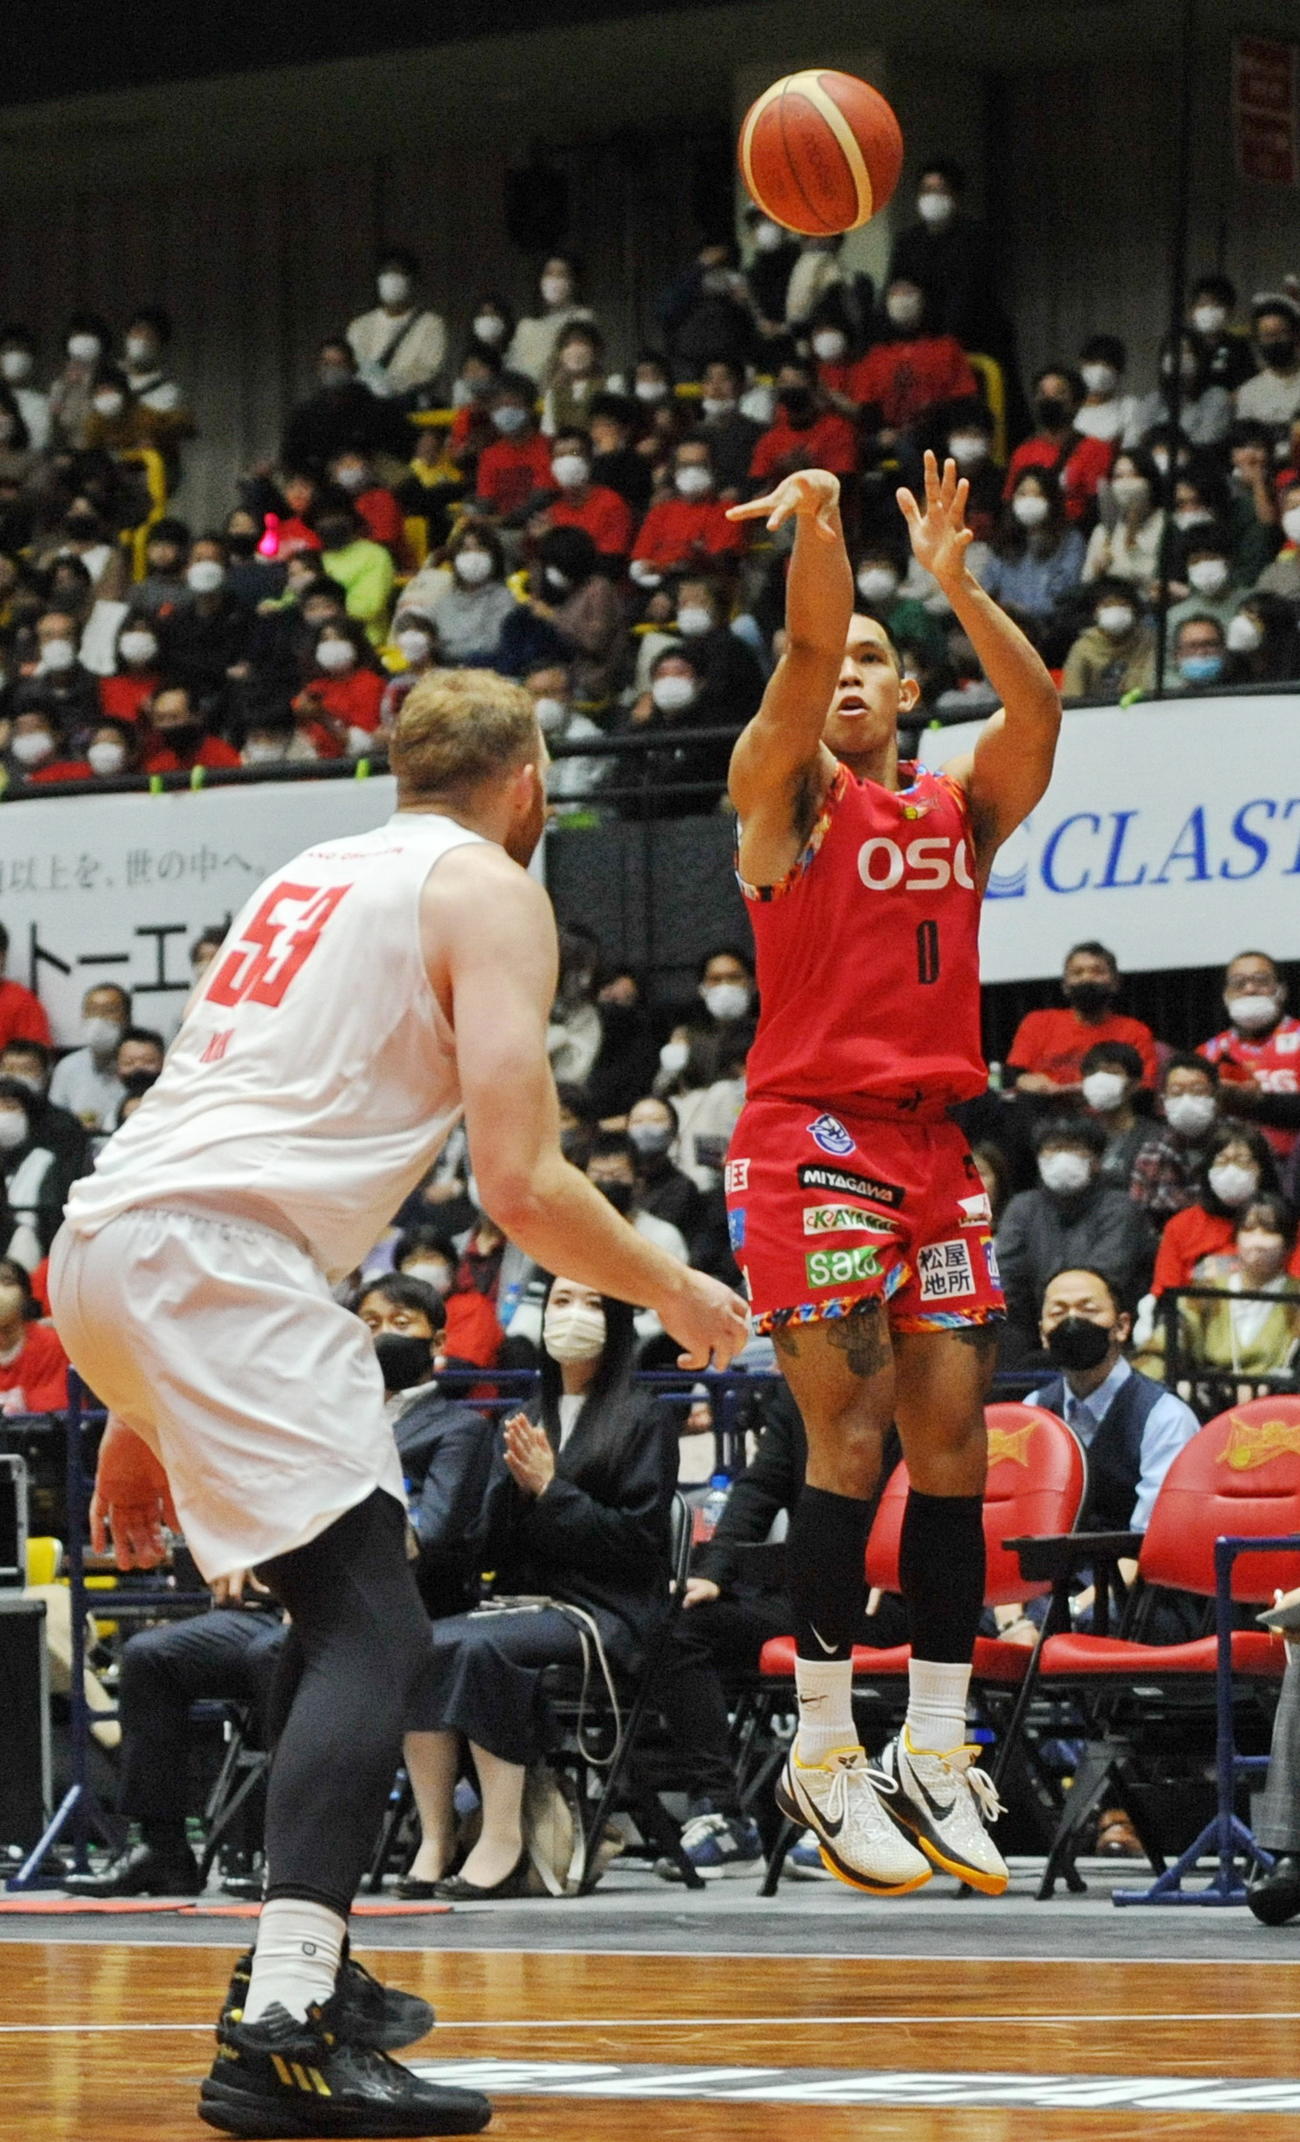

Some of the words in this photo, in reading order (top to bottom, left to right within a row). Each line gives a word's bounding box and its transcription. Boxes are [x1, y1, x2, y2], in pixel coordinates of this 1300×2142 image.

[0, 845, 267, 893] 以上を、世の中へ。
[30, 911, 231, 995] トーエ
[917, 920, 940, 985] 0
[803, 1169, 894, 1202] MIYAGAWA
[920, 1243, 968, 1273] 松屋
[923, 1268, 971, 1296] 地所
